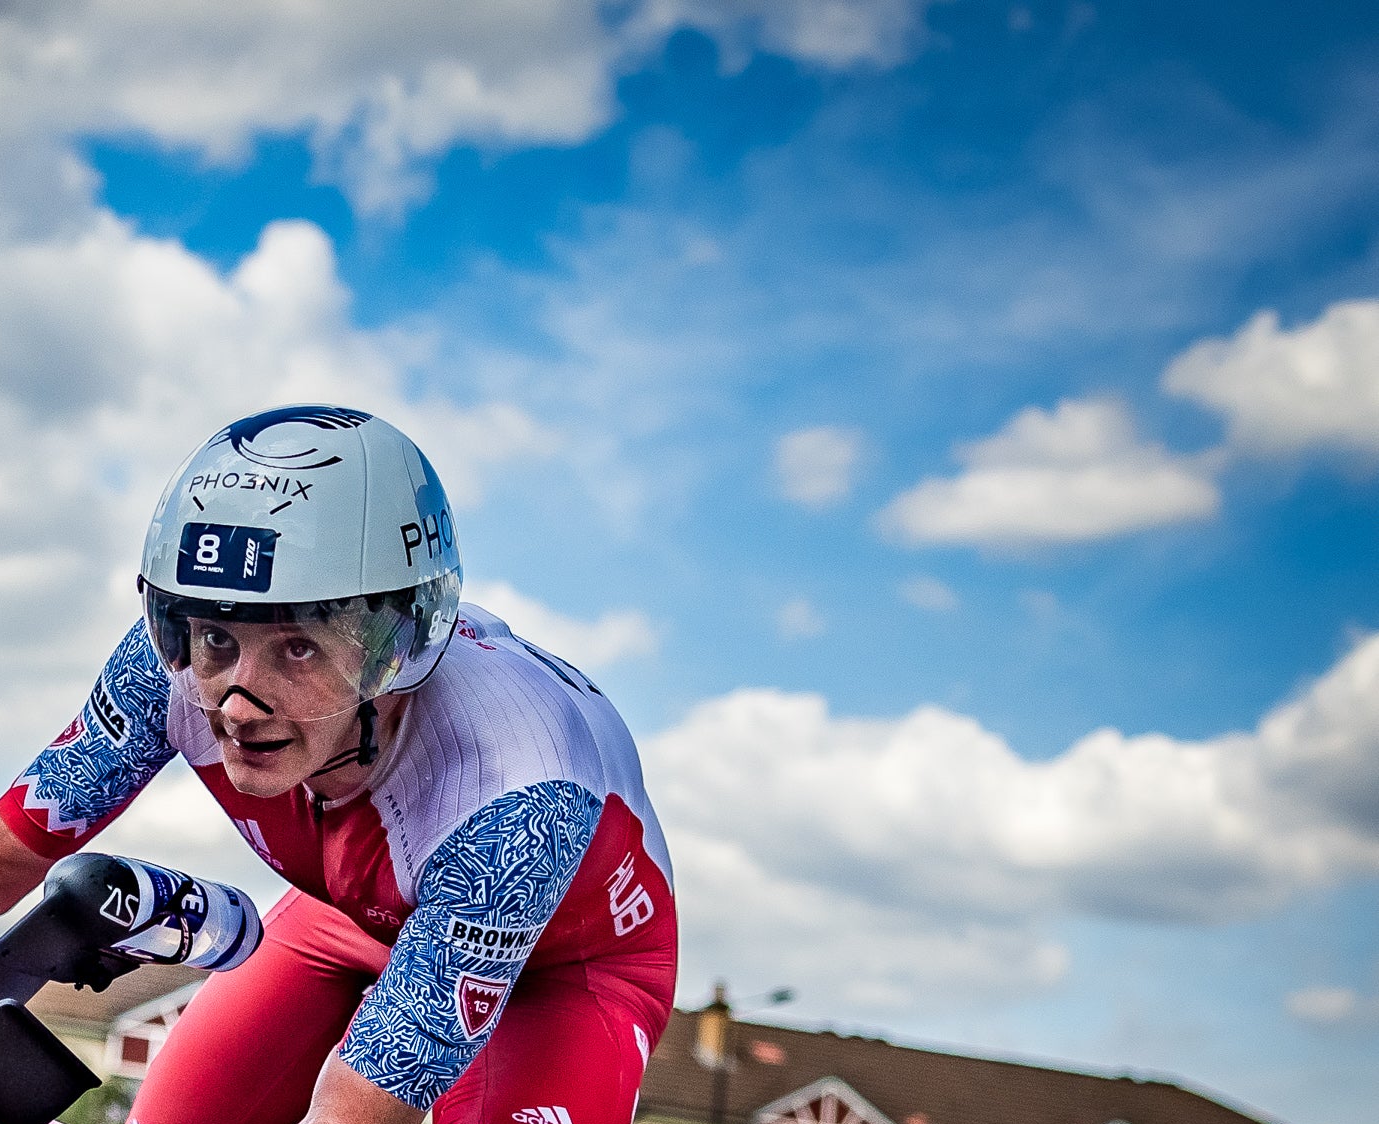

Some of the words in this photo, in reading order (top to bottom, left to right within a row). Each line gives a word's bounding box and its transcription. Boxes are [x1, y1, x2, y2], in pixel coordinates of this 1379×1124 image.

[196, 534, 221, 565] 8
[242, 537, 257, 579] T100
[193, 565, 208, 573] PRO
[207, 566, 224, 574] MEN
[474, 1000, 489, 1014] 13
